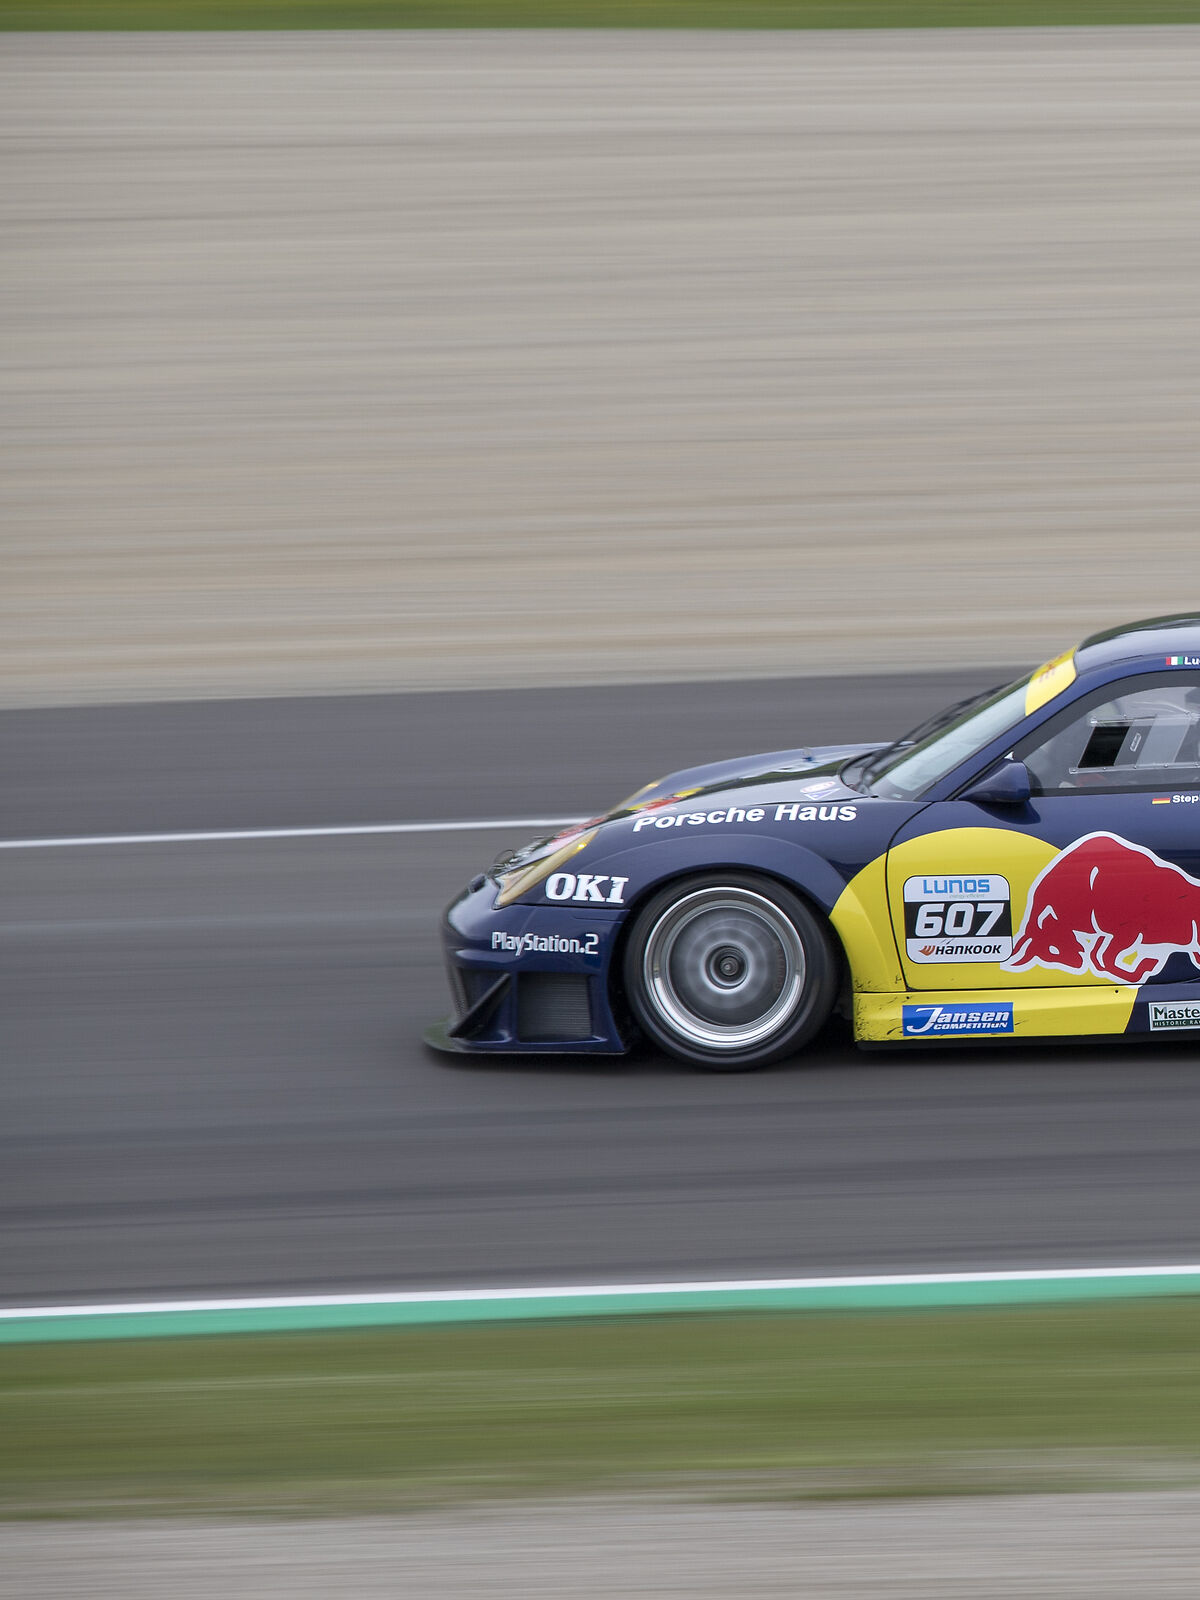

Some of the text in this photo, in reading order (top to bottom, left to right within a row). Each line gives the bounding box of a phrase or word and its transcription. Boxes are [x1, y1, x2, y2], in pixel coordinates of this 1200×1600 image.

[633, 803, 857, 832] Porsche Haus
[545, 873, 630, 904] OKI
[923, 879, 990, 894] LUNOS
[915, 902, 1005, 937] 607
[906, 1007, 1010, 1033] Jansen
[933, 1021, 1009, 1030] COMPETITION
